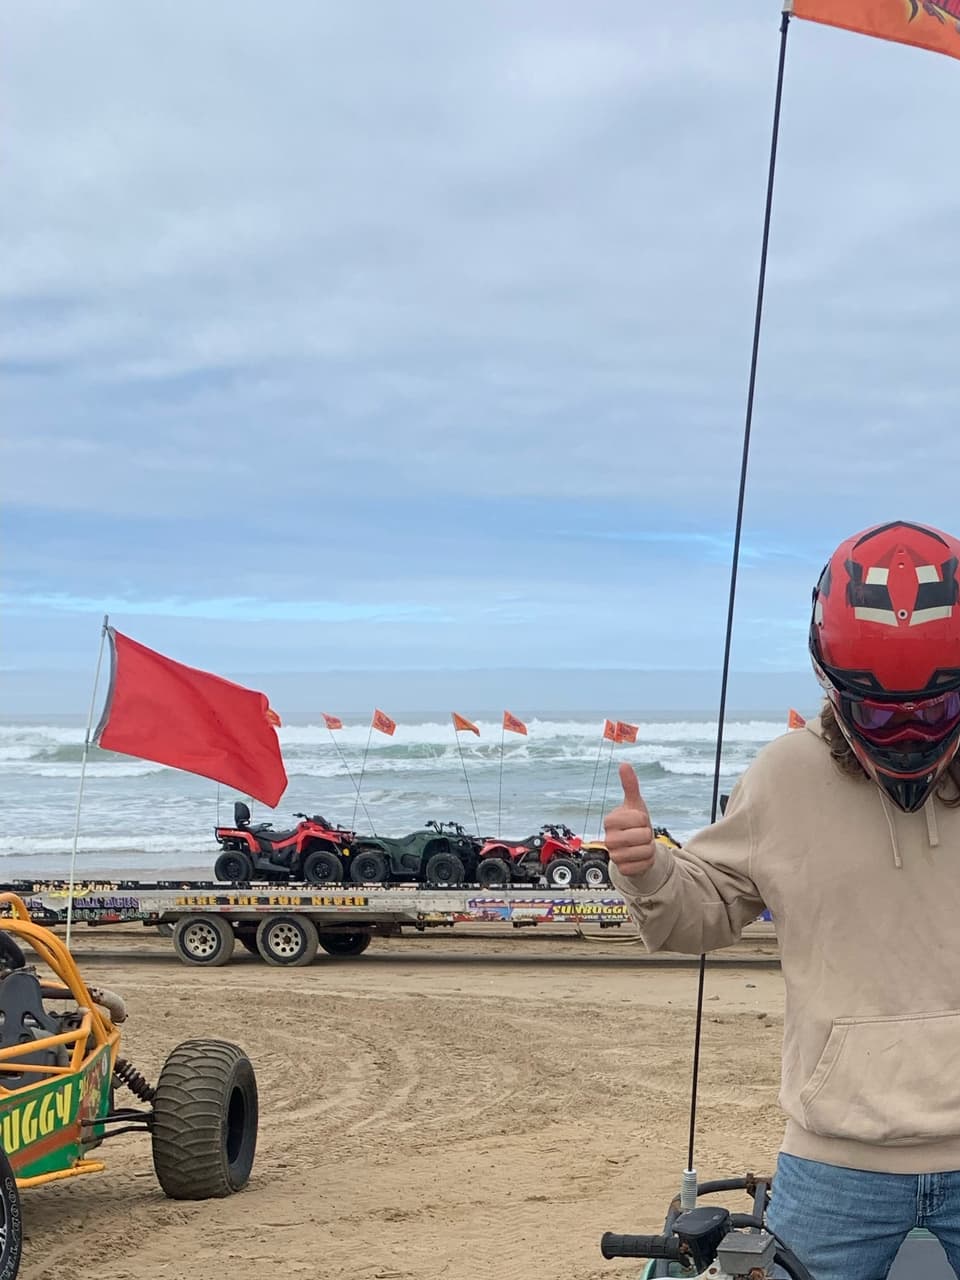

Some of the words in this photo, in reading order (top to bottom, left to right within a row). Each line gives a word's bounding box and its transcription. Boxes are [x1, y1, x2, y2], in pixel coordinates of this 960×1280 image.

[226, 896, 258, 905] THE
[312, 896, 365, 906] NEVER
[553, 904, 628, 914] SUNBUGGI
[0, 1082, 73, 1154] UGGY
